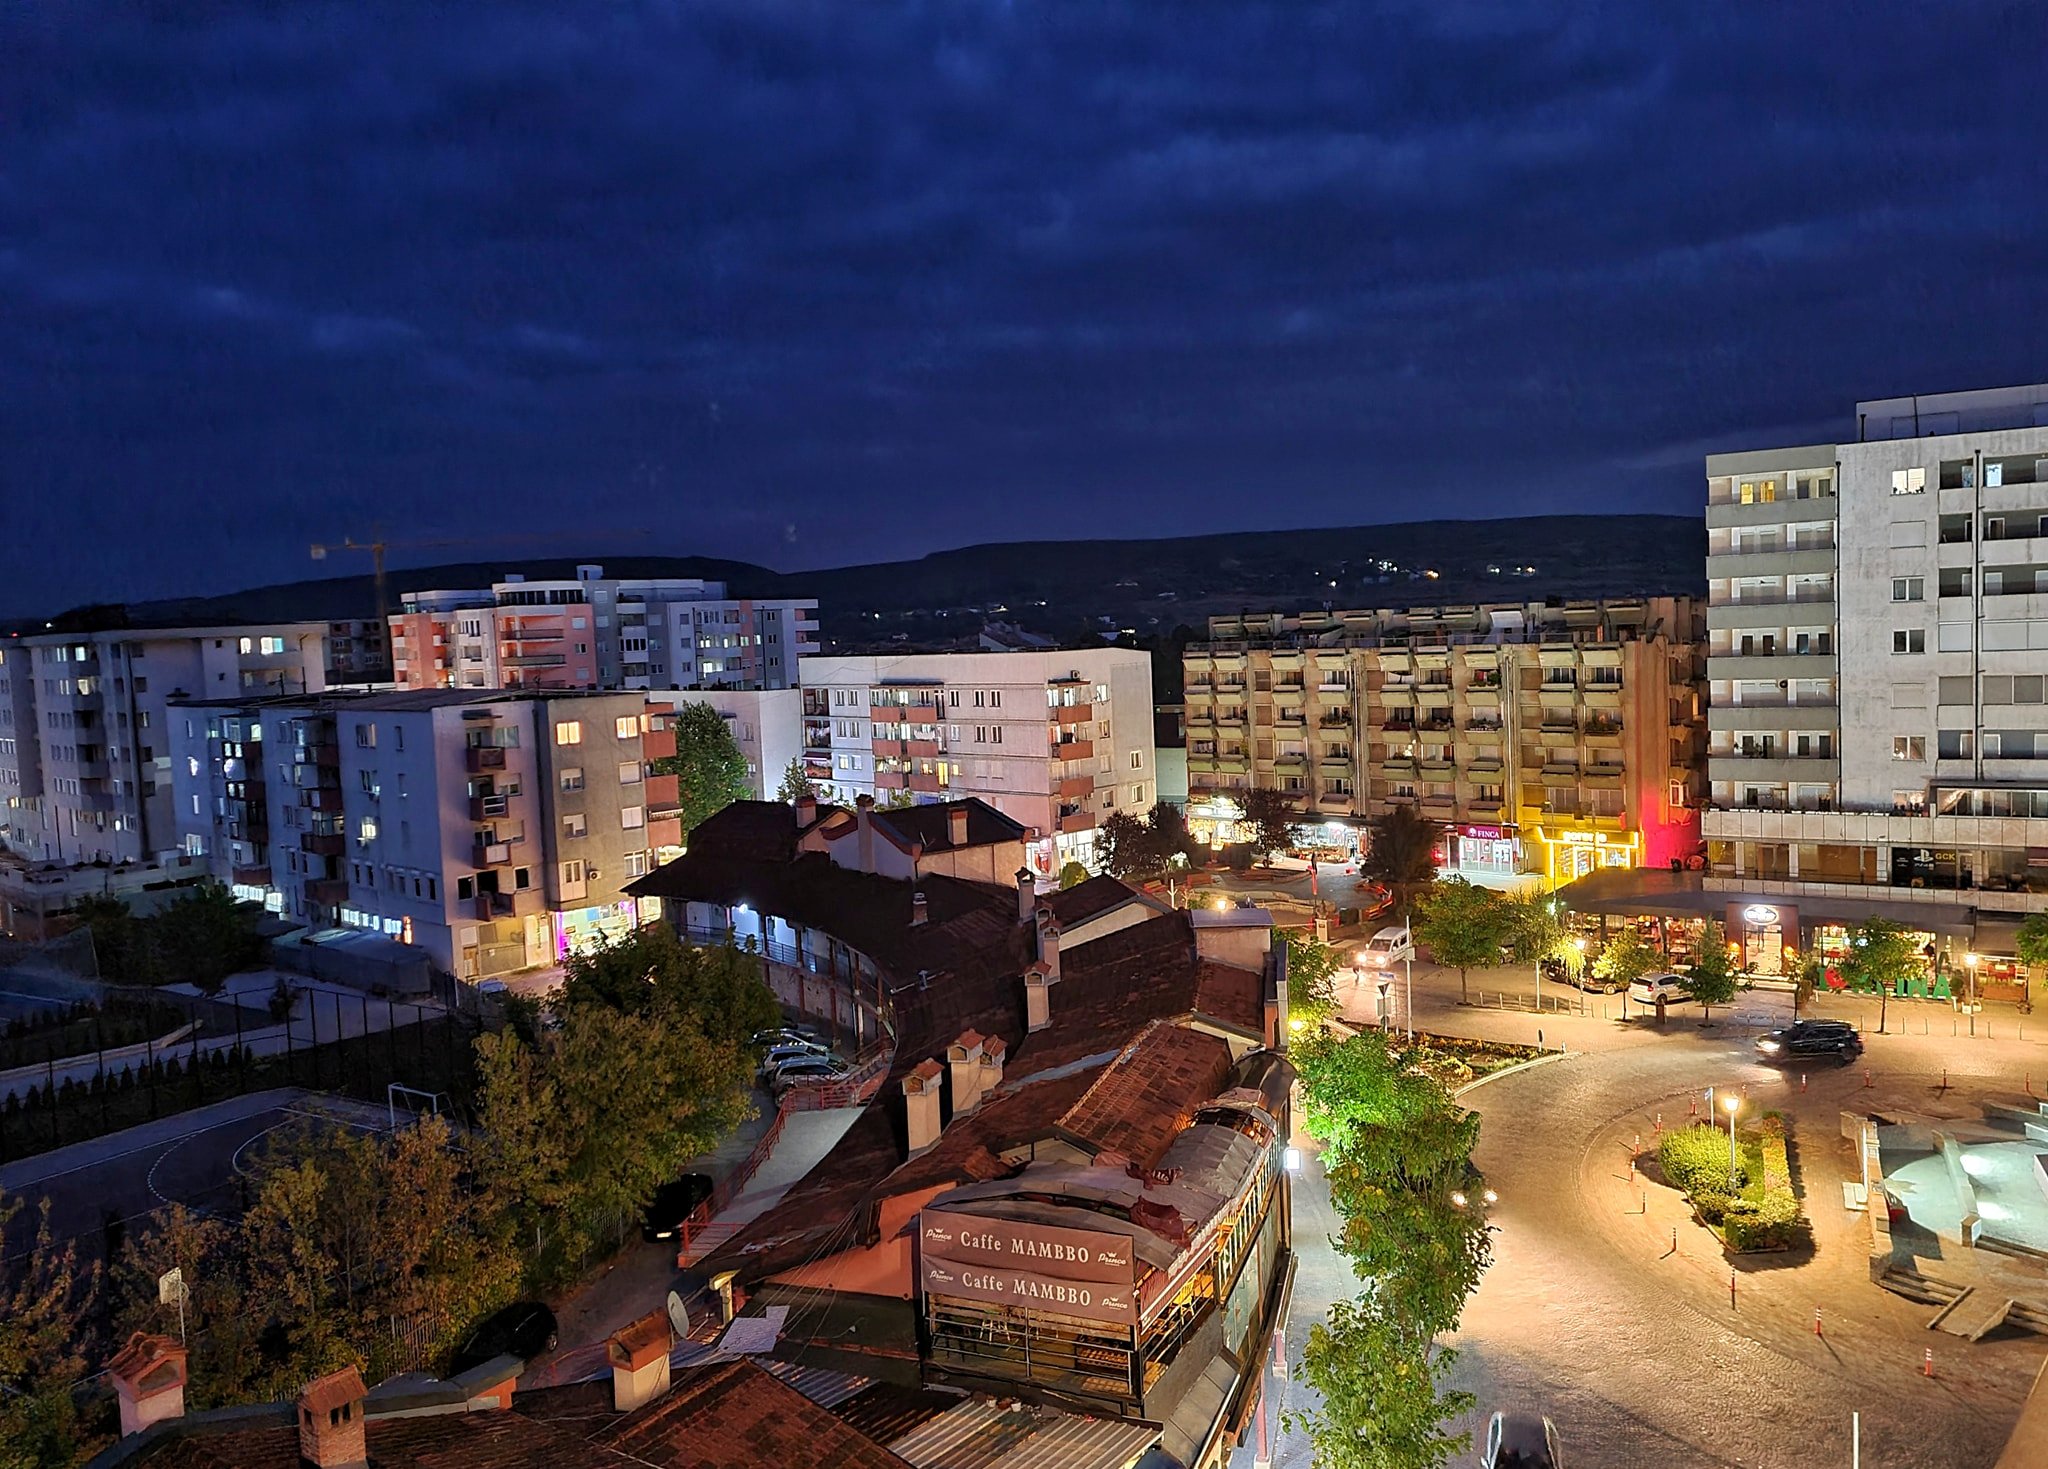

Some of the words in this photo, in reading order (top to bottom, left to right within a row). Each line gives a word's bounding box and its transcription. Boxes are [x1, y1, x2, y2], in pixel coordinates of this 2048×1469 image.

[1477, 830, 1500, 839] FINCA
[1935, 852, 1957, 861] GCK
[960, 1231, 1001, 1251] Caffe
[1011, 1238, 1089, 1263] MAMBBO
[962, 1272, 1003, 1292] Caffe
[1013, 1279, 1091, 1306] MAMBBO
